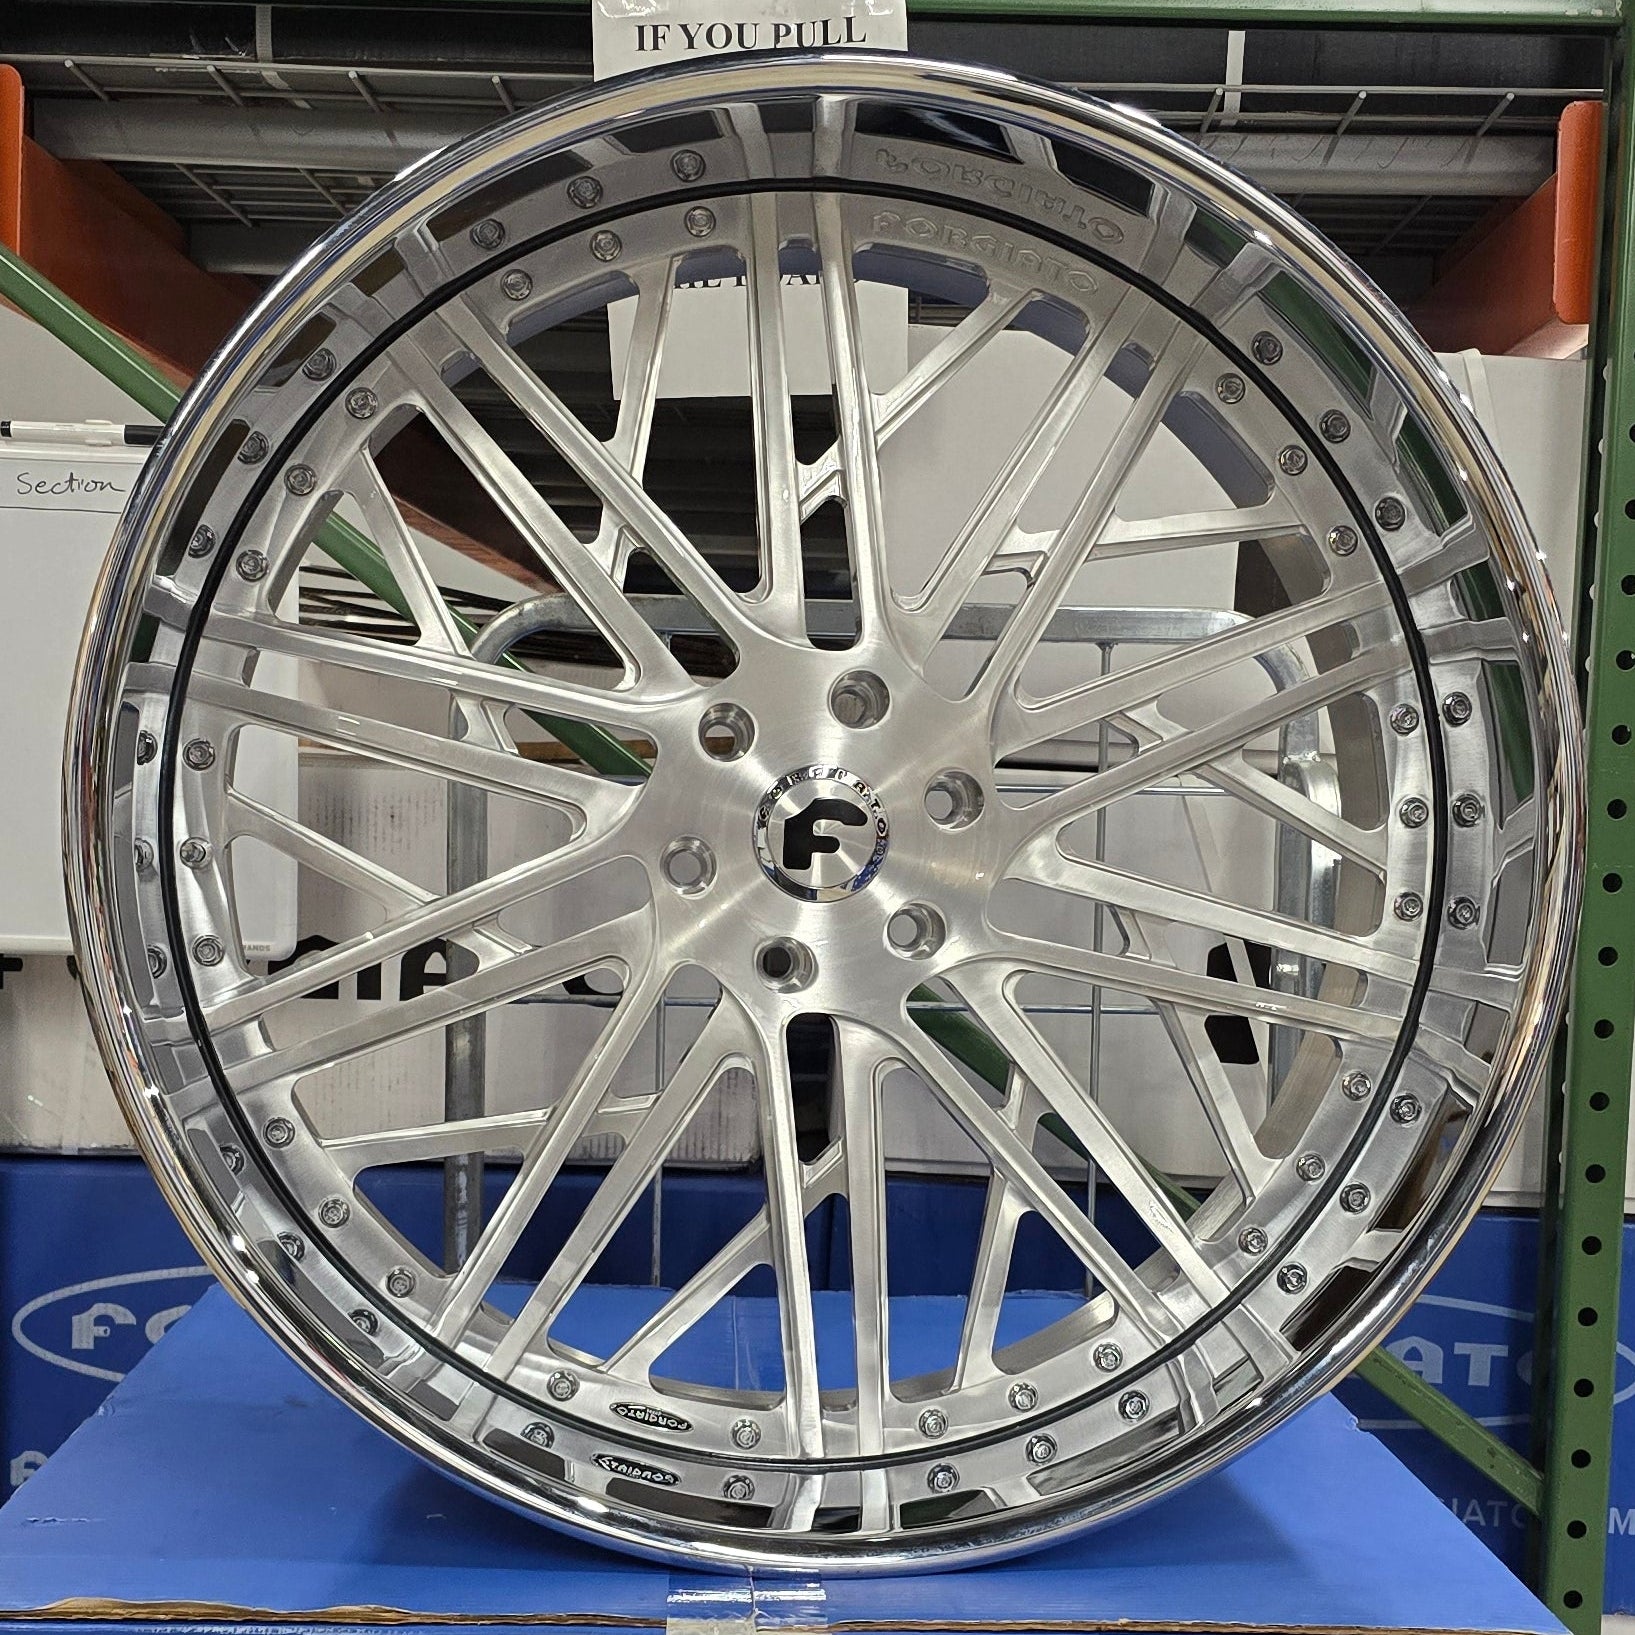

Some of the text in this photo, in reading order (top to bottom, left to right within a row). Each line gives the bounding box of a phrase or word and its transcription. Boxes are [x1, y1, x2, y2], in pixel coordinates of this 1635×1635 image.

[634, 16, 867, 51] IF YOU PULL
[872, 210, 1100, 297] FORGIATO
[16, 471, 126, 495] Section
